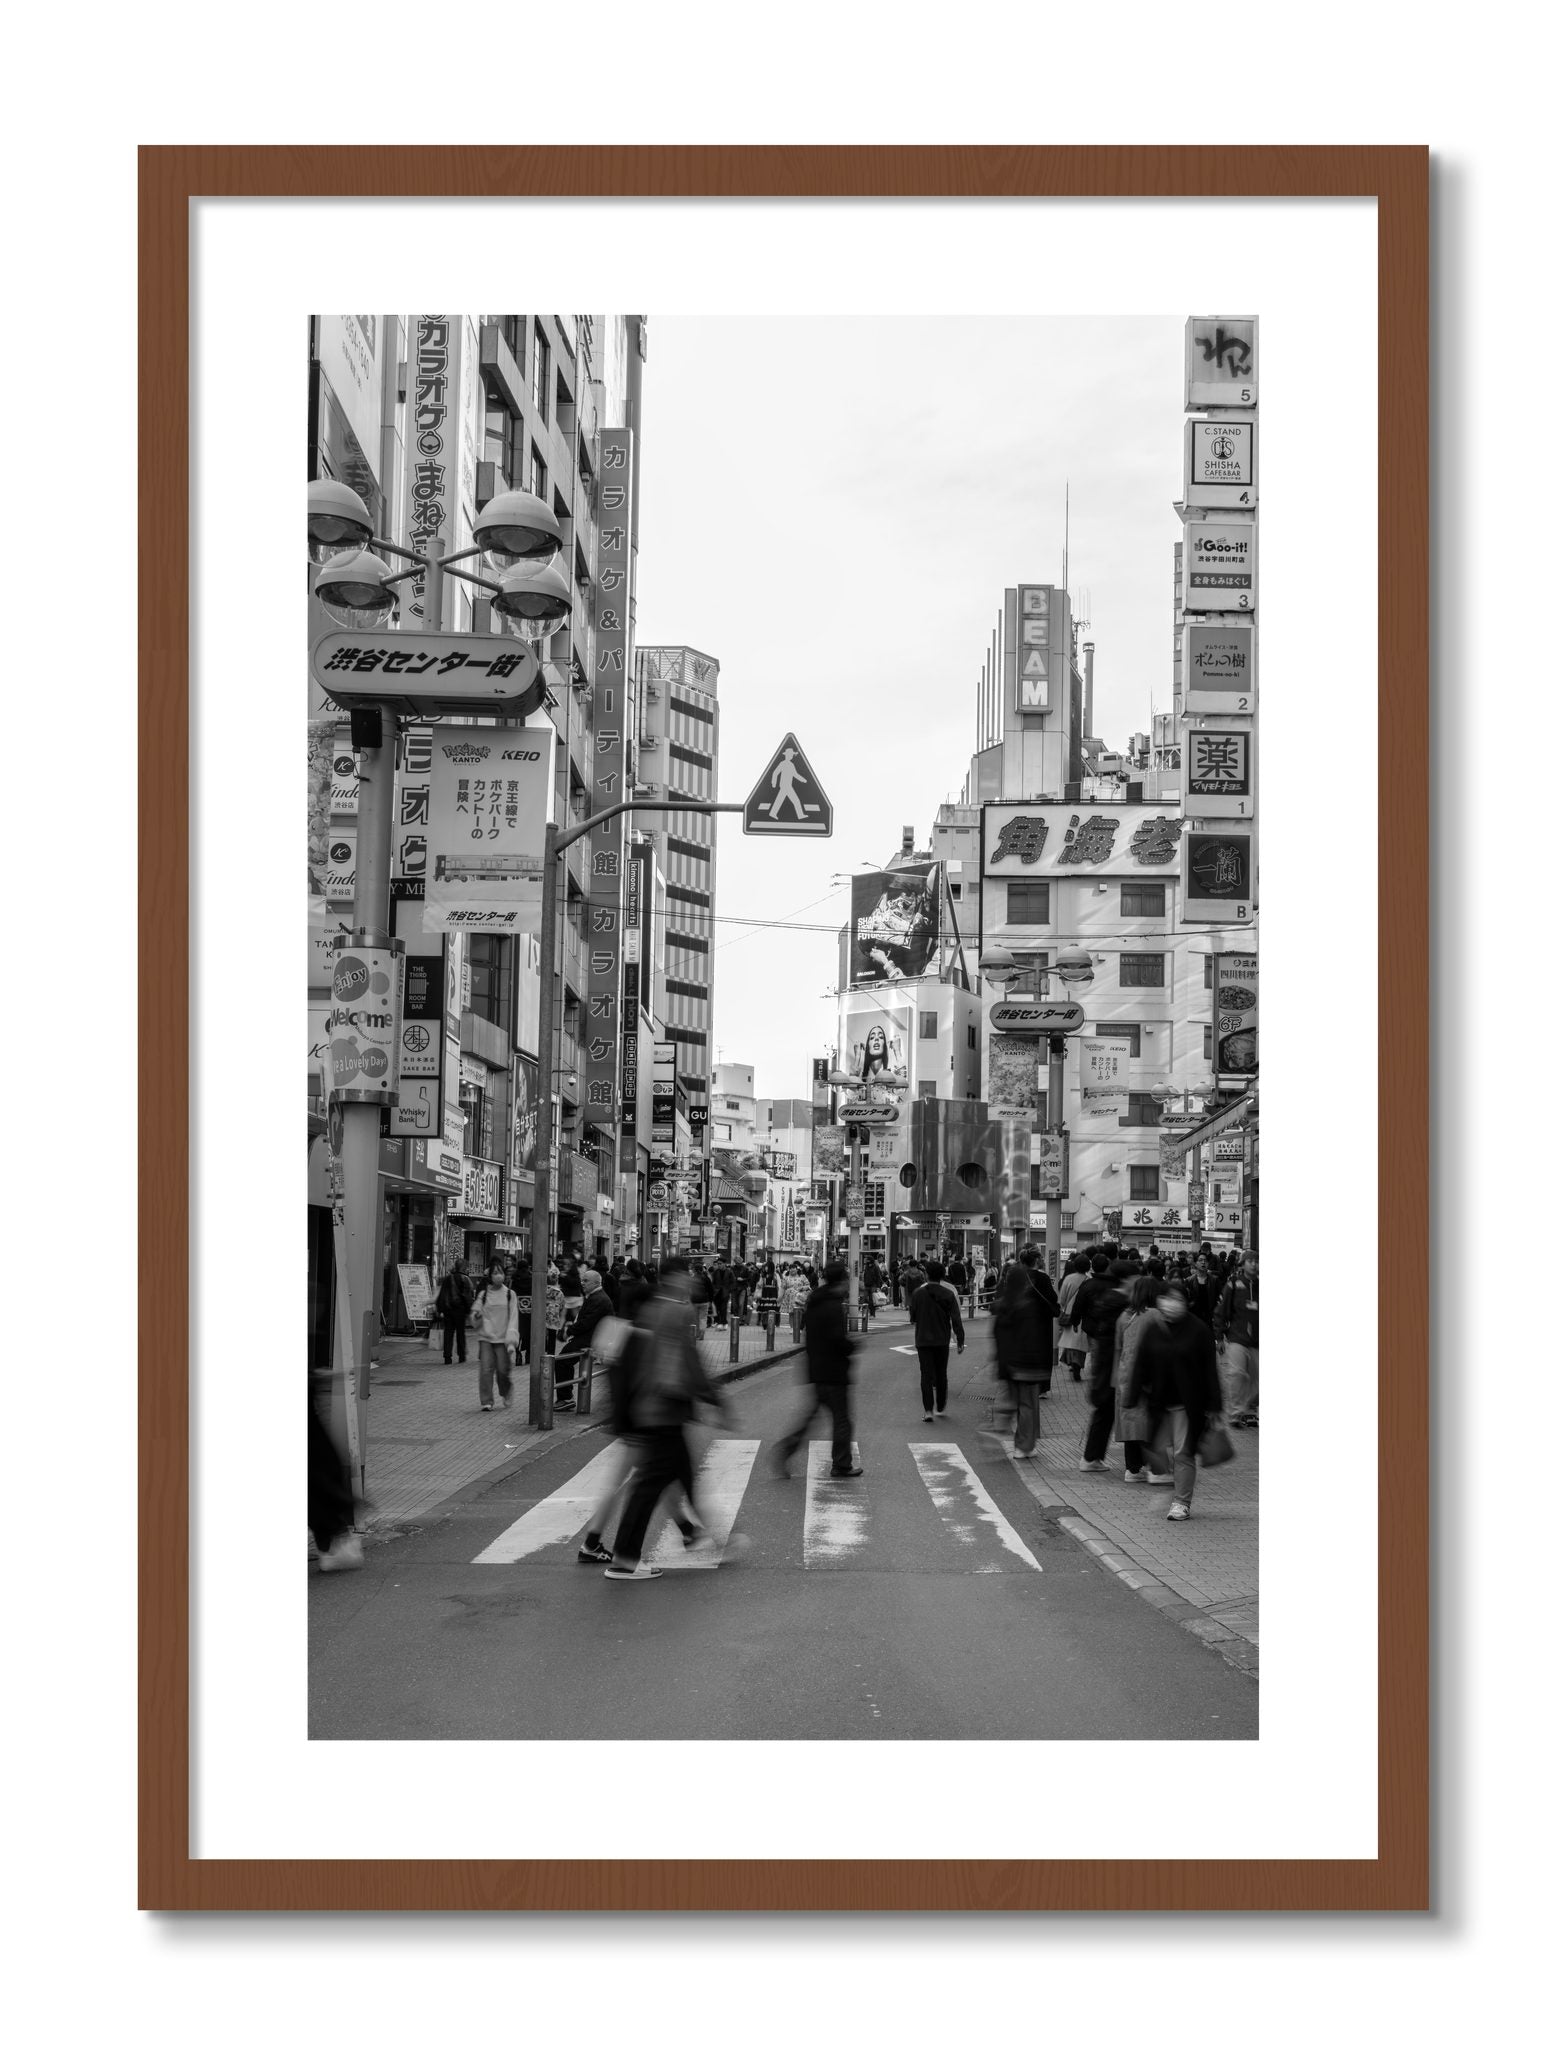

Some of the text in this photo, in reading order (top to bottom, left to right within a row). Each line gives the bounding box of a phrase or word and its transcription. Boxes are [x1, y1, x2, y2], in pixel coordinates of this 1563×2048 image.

[414, 321, 448, 432] カラオケ
[1241, 389, 1251, 401] 5
[1204, 427, 1242, 436] C.STAND
[1204, 461, 1241, 470] SHISHA
[1239, 492, 1250, 505] 4
[1203, 540, 1248, 553] Goo-it!
[1194, 576, 1249, 585] 全身もみほぐし
[1239, 595, 1249, 608] 3
[1022, 588, 1049, 706] BEAM
[323, 647, 526, 678] 渋谷センター街
[1238, 697, 1248, 710] 2
[501, 750, 541, 761] KEIO
[1197, 737, 1239, 778] 薬
[456, 779, 470, 814] 冒険へ
[471, 779, 486, 839] カントーの
[505, 780, 519, 829] 京王線で
[1238, 801, 1245, 814] 1
[991, 814, 1185, 865] 角海老
[446, 911, 519, 922] 渋谷センター街
[1237, 906, 1246, 919] B
[334, 966, 367, 995] Enjoy
[331, 1008, 393, 1028] Welcome
[995, 1009, 1079, 1020] 渋谷センター街
[1219, 1016, 1242, 1032] 6F
[344, 1056, 369, 1071] Lovely
[399, 1107, 426, 1117] Whisky
[690, 1111, 708, 1120] GU
[398, 1115, 415, 1123] Bank
[1133, 1207, 1182, 1226] 兆楽
